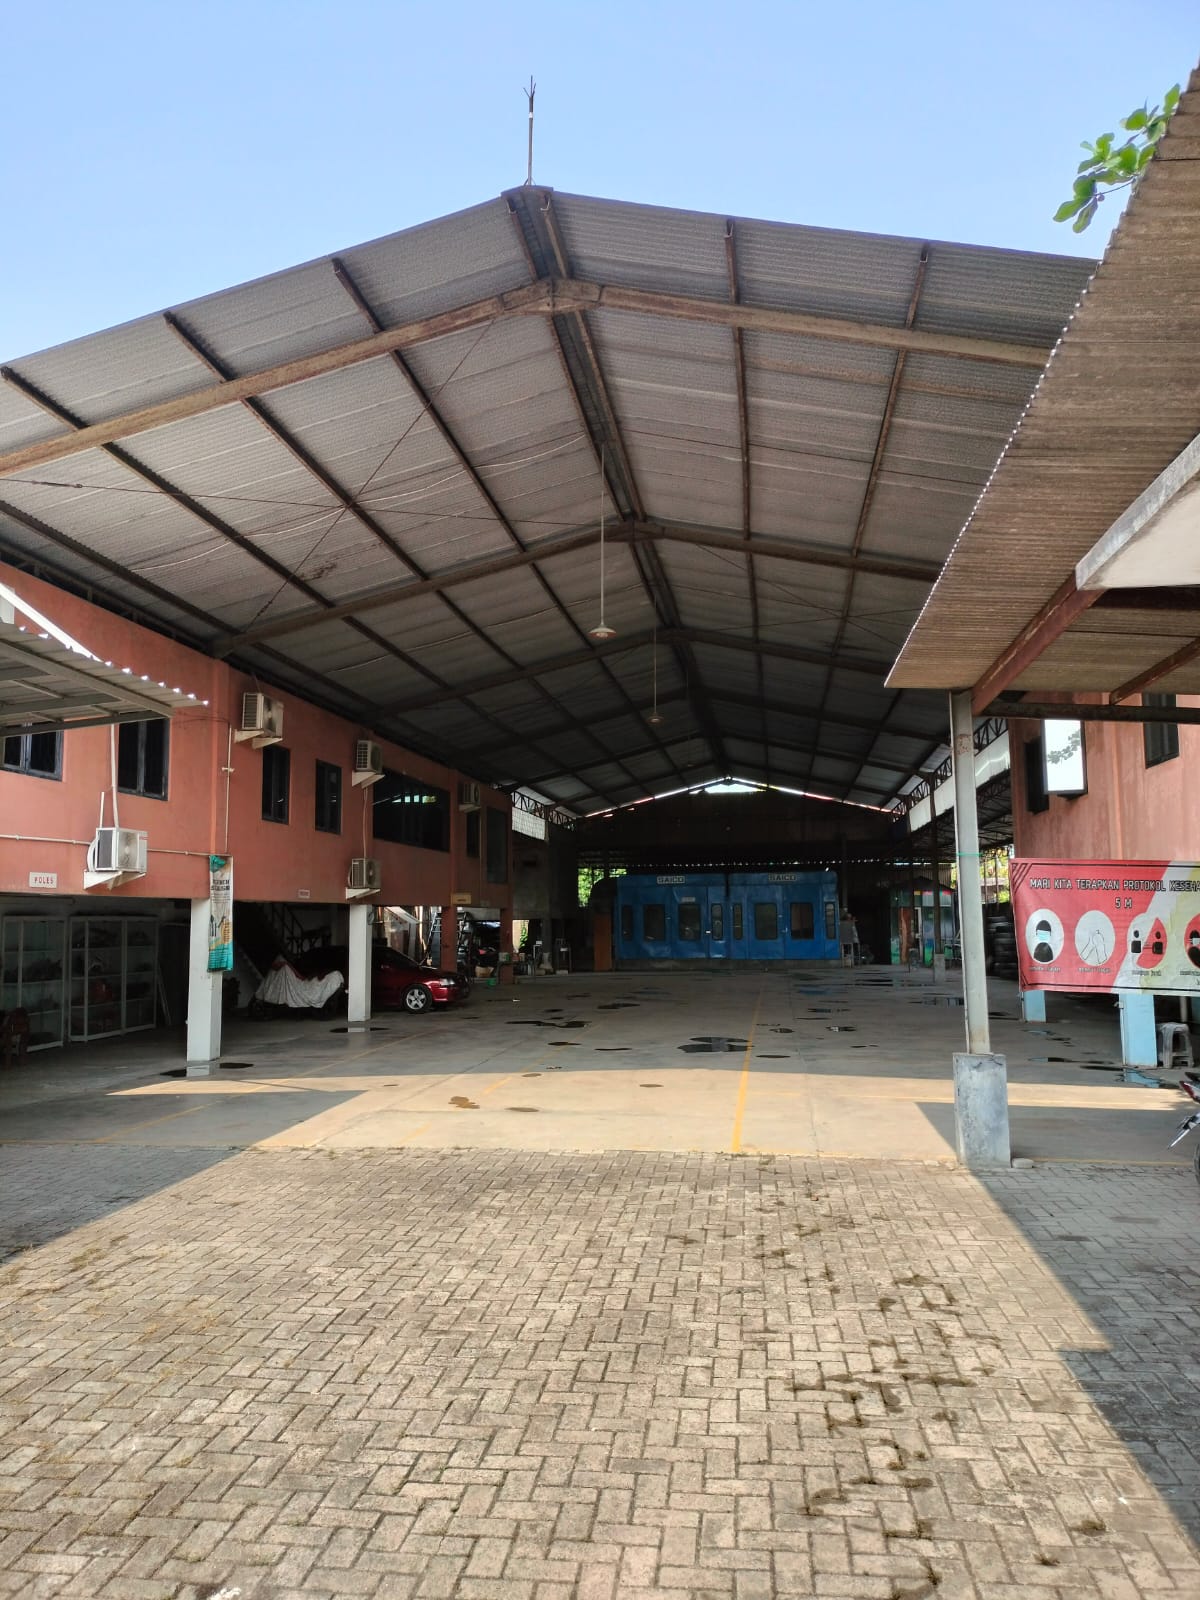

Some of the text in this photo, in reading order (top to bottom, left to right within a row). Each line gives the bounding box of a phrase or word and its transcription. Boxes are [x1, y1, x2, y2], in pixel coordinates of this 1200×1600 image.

[34, 876, 53, 884] POLES
[1029, 878, 1051, 889] MARI
[1054, 878, 1072, 890] KITA
[1076, 879, 1120, 890] TERAPKAN
[1123, 880, 1166, 891] PROTOKOL
[1115, 897, 1132, 909] 5 M
